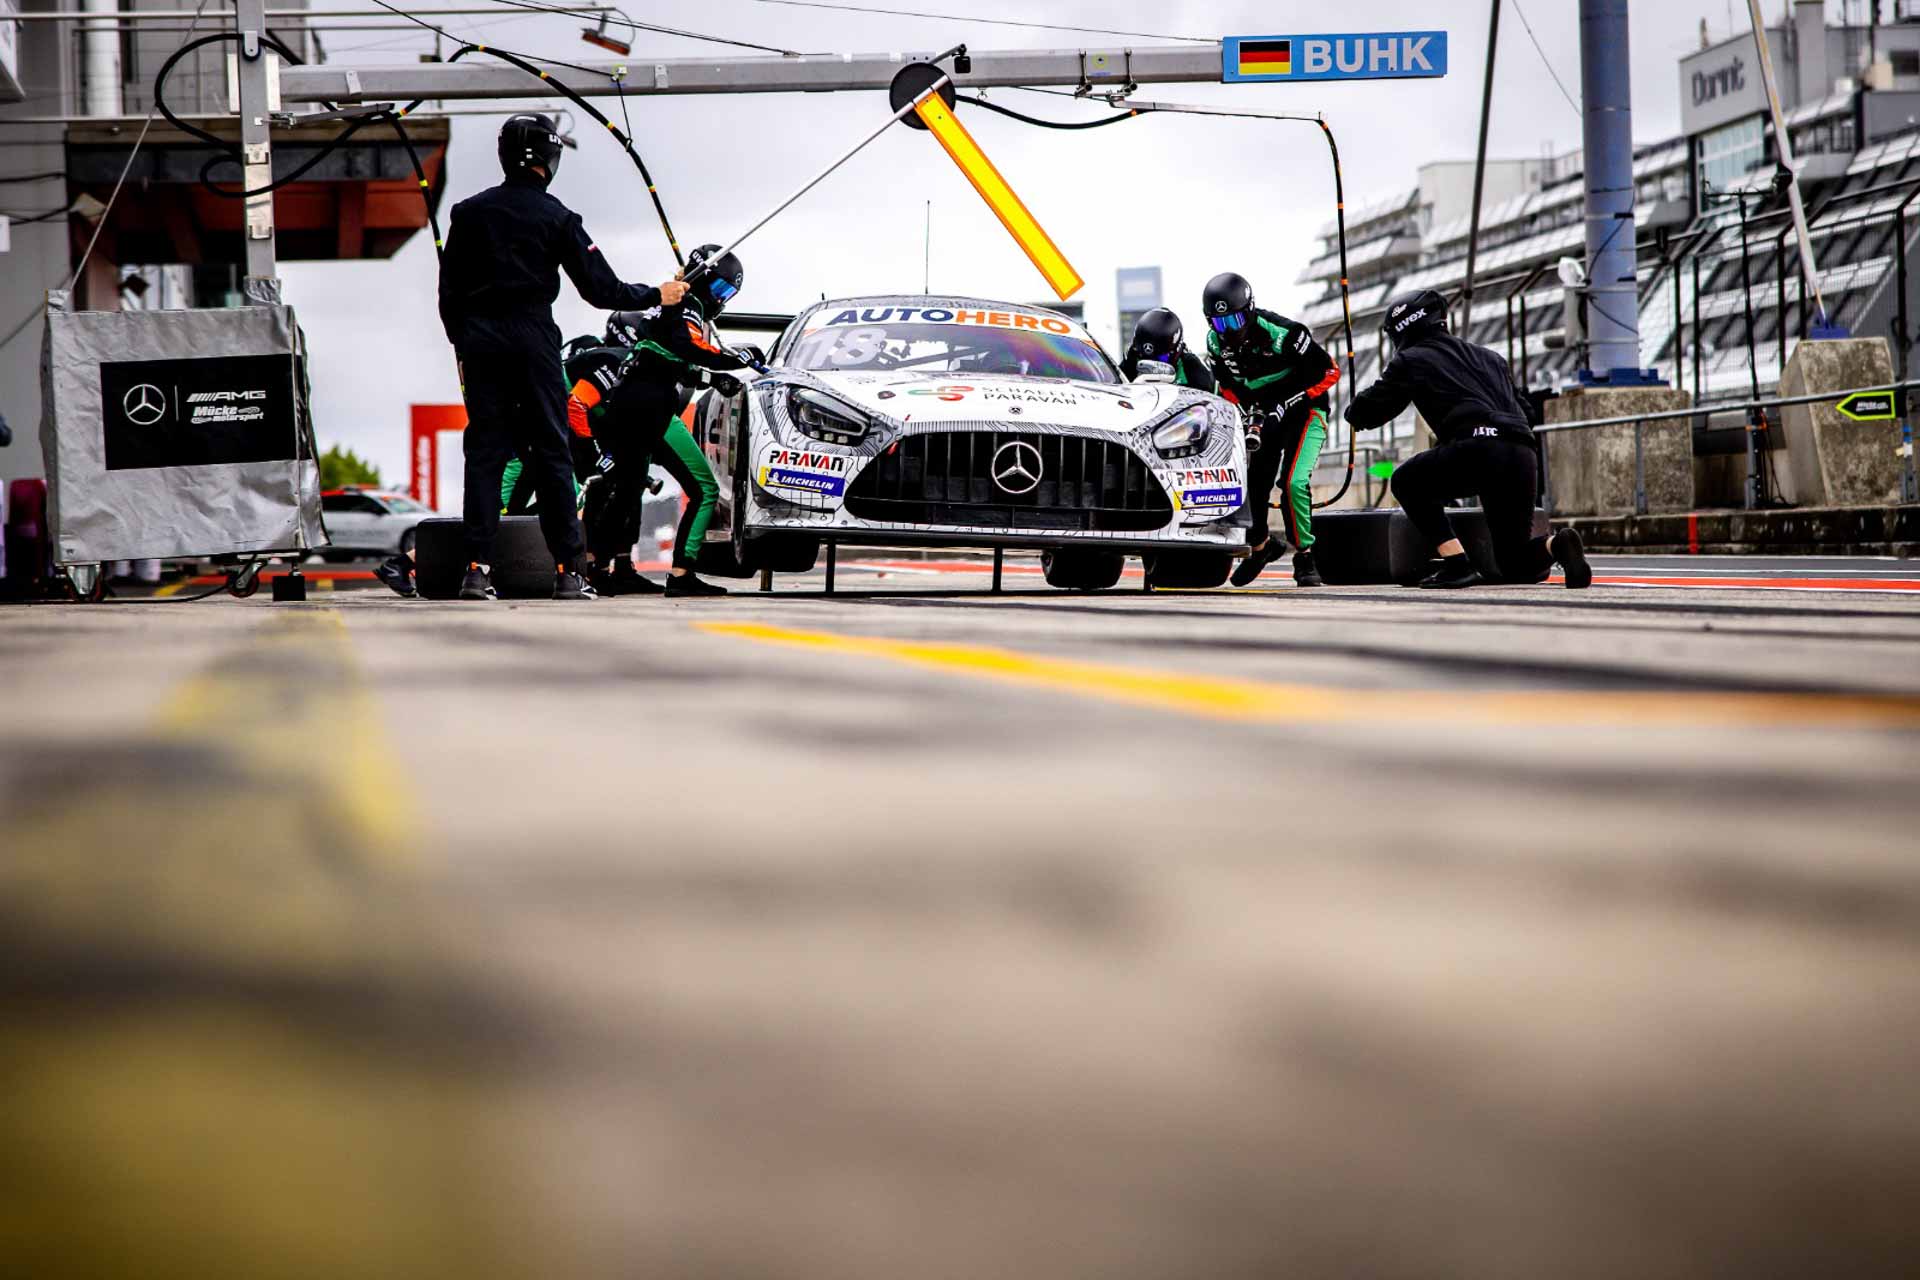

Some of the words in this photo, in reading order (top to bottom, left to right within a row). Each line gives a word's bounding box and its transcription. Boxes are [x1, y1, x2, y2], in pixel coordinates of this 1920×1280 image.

[1304, 37, 1433, 73] BUHK
[827, 308, 1070, 334] AUTOHERO
[1395, 308, 1428, 332] uvex
[803, 327, 887, 368] 18
[213, 391, 266, 400] AMG
[984, 393, 1078, 405] PARAVAN
[194, 405, 237, 416] Mücke
[769, 450, 845, 472] PARAVAN
[781, 475, 834, 490] MICHELIN
[1176, 468, 1238, 487] PARAVAN
[1195, 493, 1237, 504] MICHELIN
